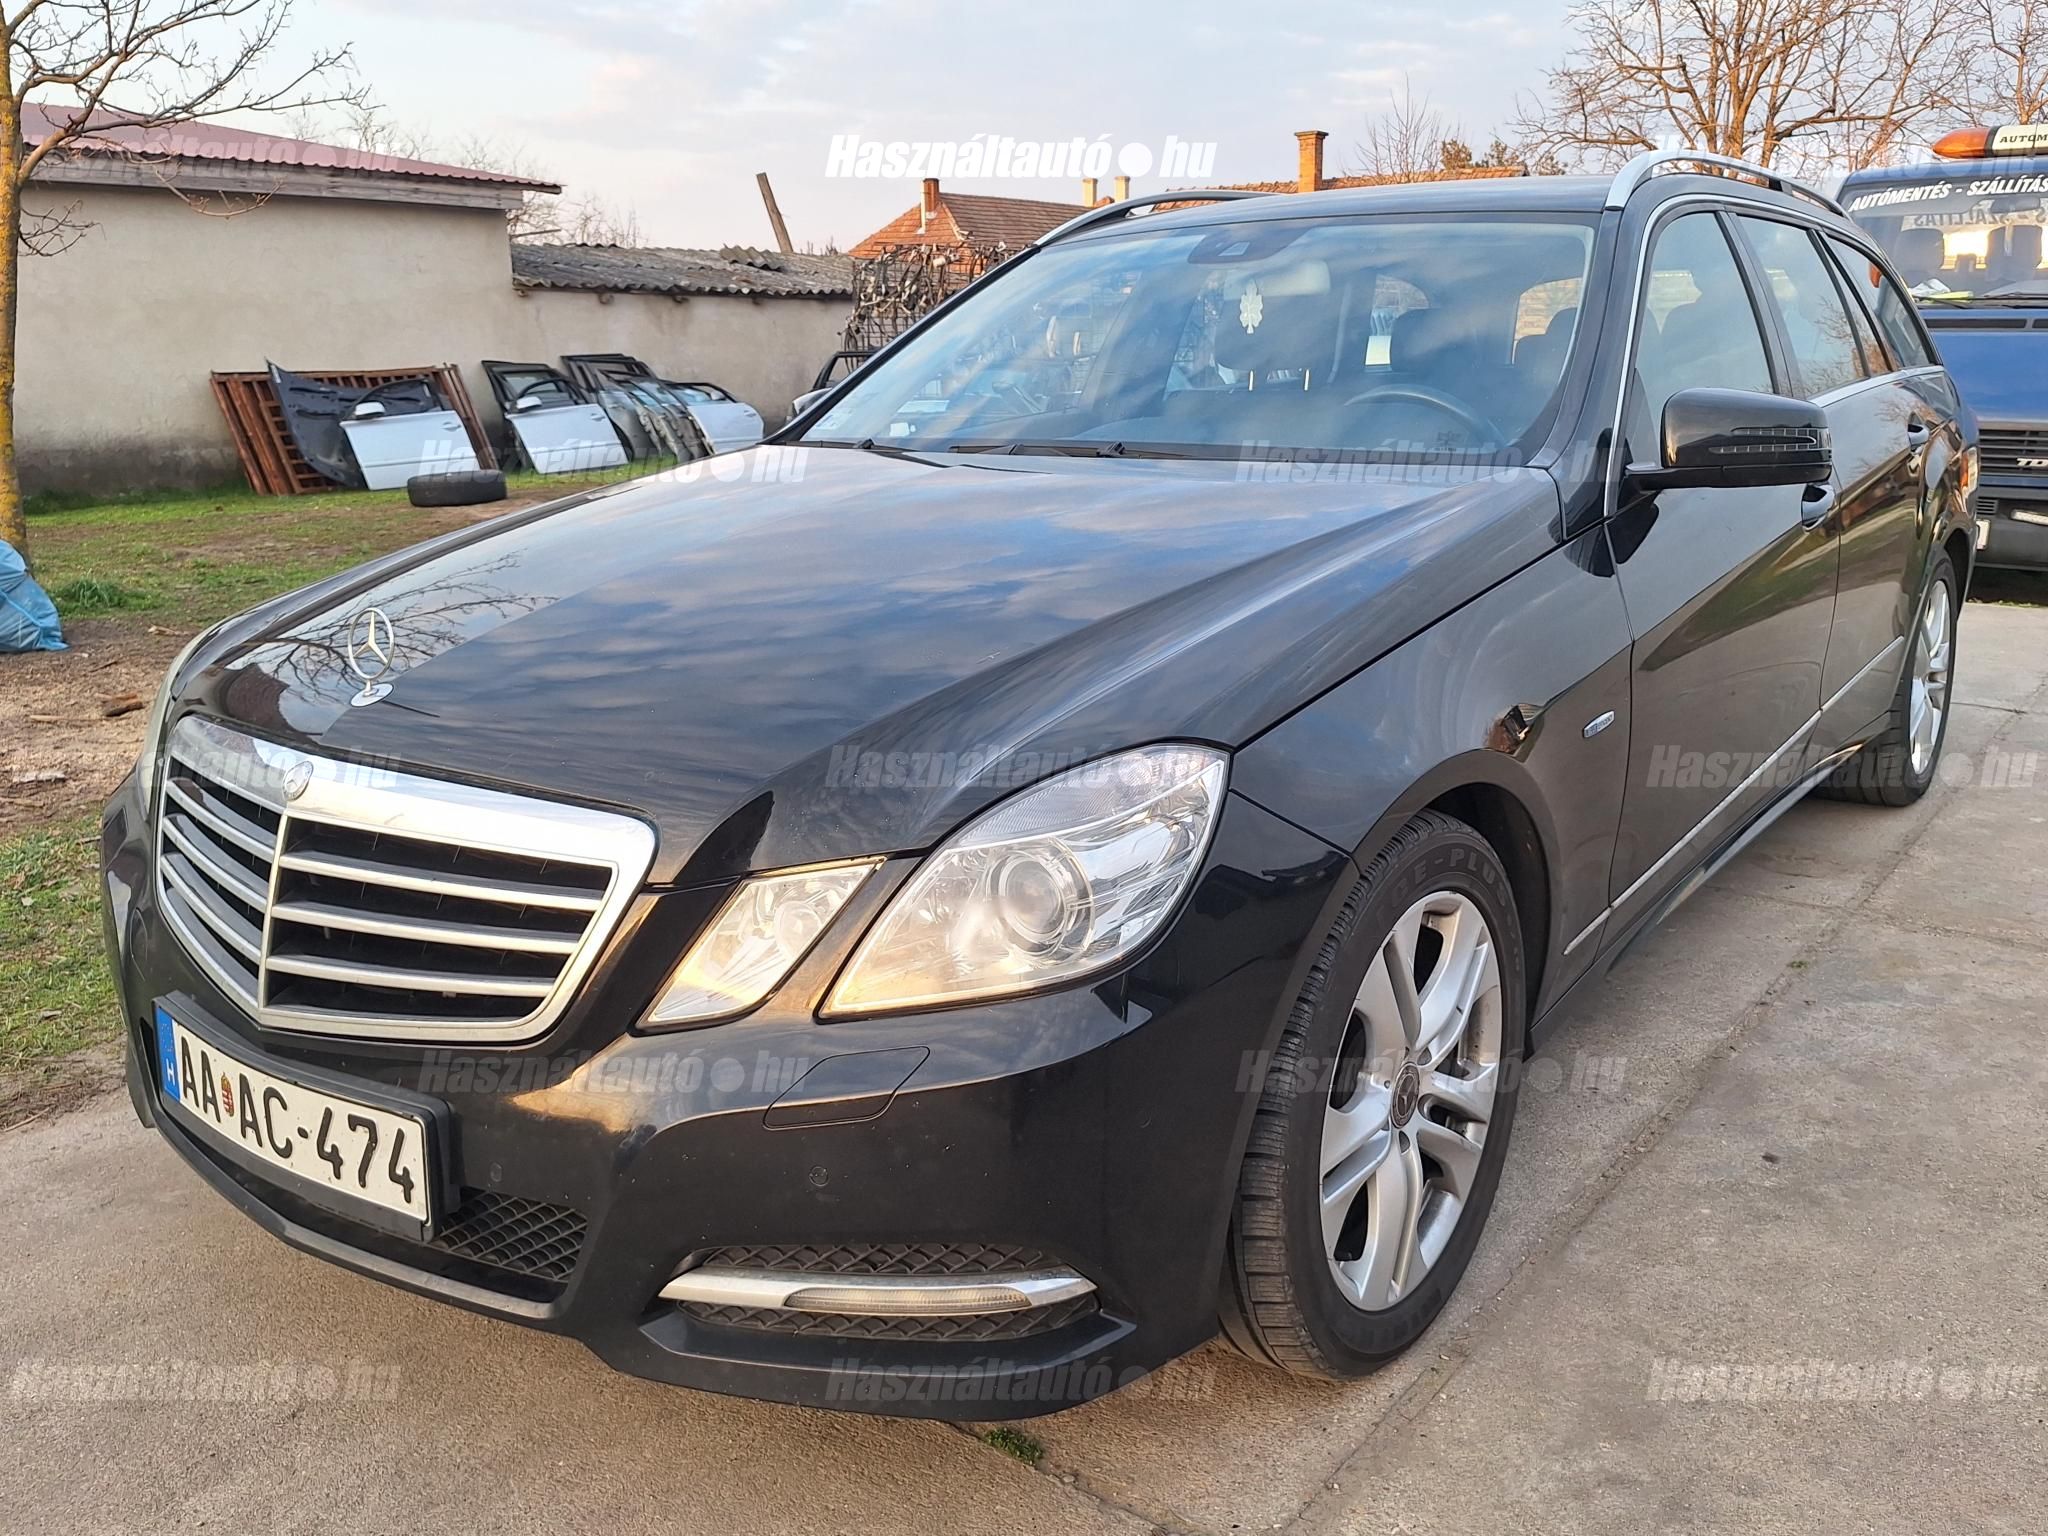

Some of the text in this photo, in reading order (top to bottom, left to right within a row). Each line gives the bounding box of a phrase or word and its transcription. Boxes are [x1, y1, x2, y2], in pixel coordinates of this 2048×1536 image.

[1848, 181, 1952, 212] AUTÓMENTÉS
[1967, 175, 2048, 196] SZÁLLÍTÁS
[166, 1058, 176, 1086] H
[239, 1073, 414, 1204] AC-474
